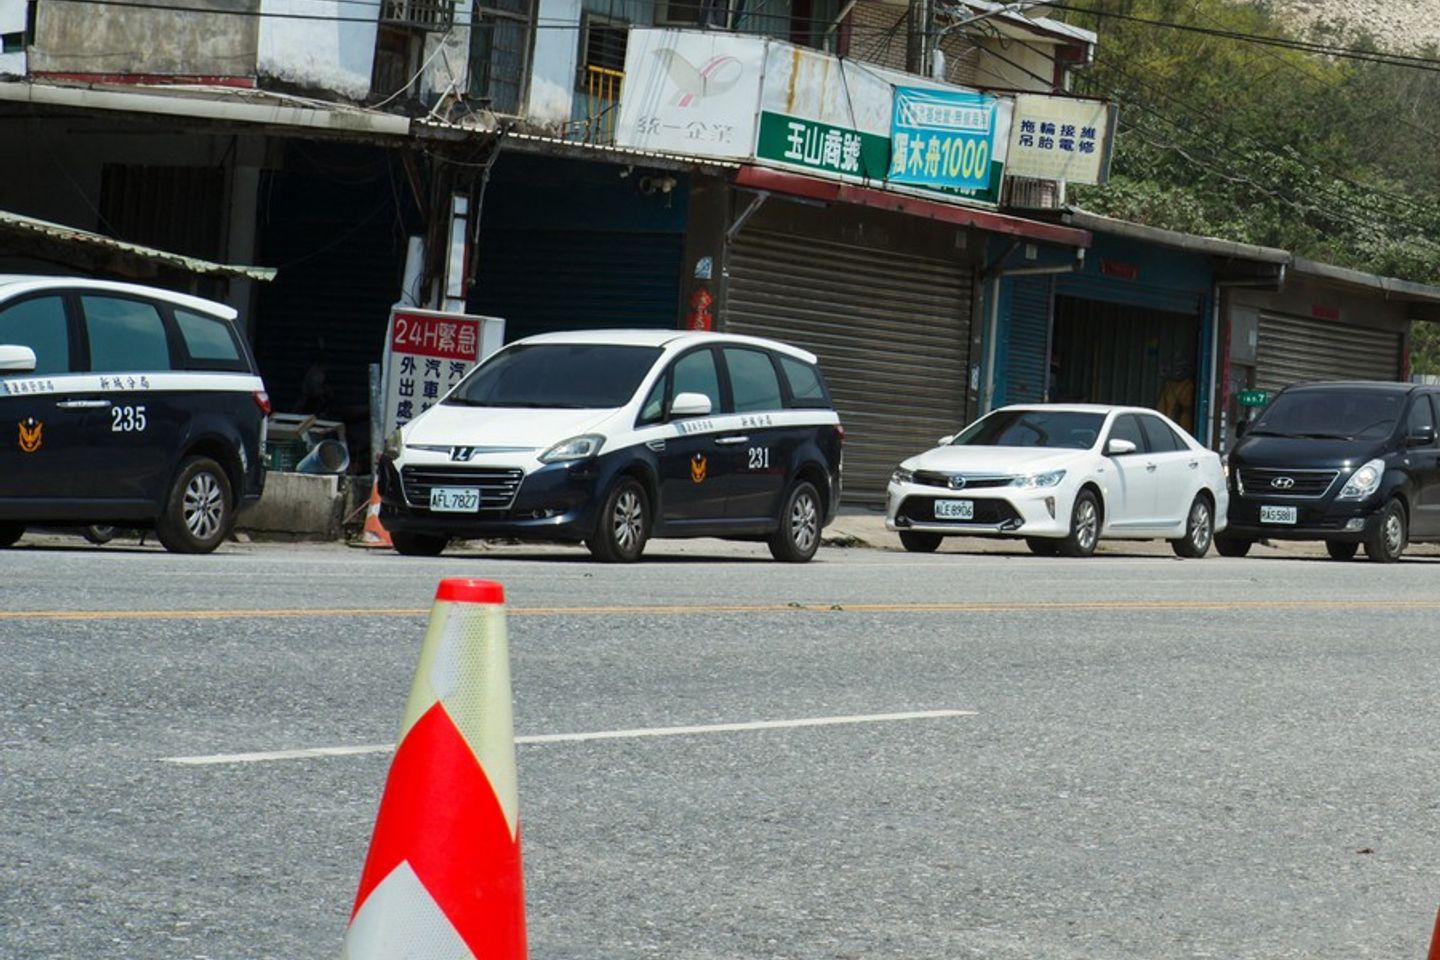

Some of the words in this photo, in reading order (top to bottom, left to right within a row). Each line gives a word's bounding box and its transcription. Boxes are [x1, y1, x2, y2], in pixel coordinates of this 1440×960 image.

[784, 121, 861, 172] 玉山商號
[111, 406, 146, 432] 235
[748, 447, 769, 469] 231
